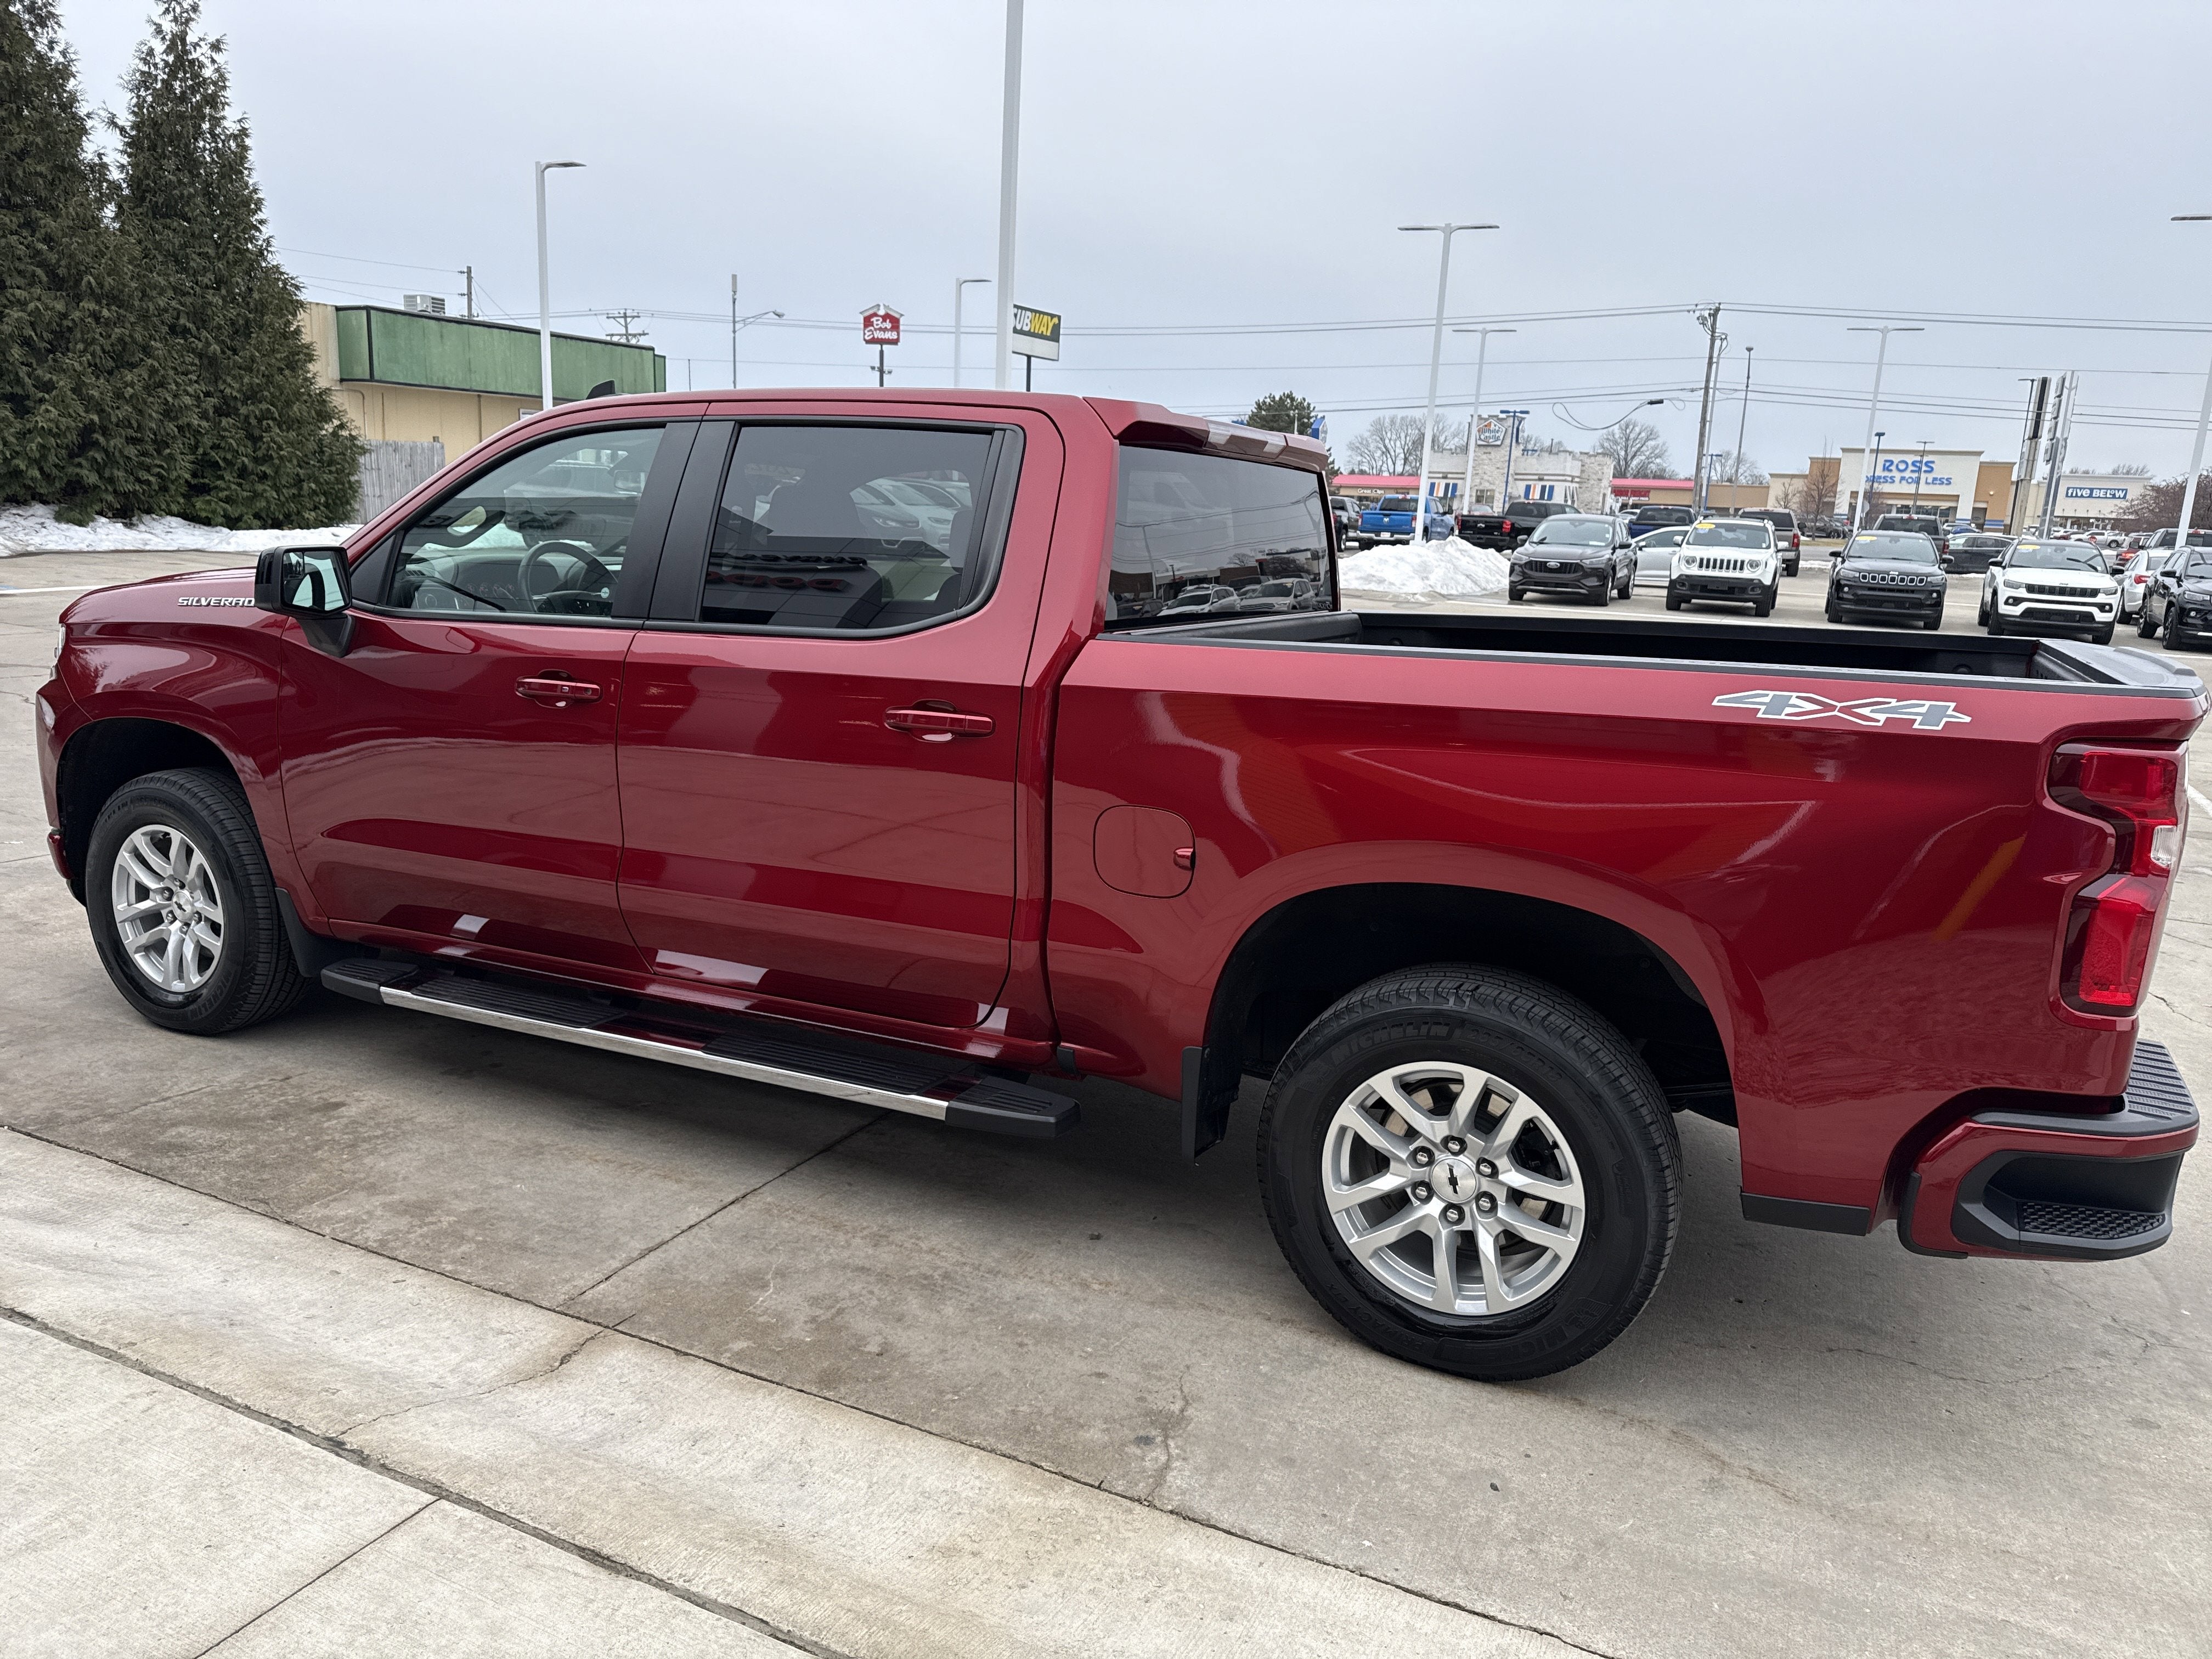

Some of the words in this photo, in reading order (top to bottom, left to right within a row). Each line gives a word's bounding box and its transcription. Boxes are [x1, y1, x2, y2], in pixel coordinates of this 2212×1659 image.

[870, 317, 891, 329] Bob
[864, 326, 898, 340] Evans
[1882, 459, 1935, 473] ROSS
[1925, 477, 1952, 485] LESS
[2068, 488, 2090, 497] five
[177, 597, 255, 607] SILVERAD
